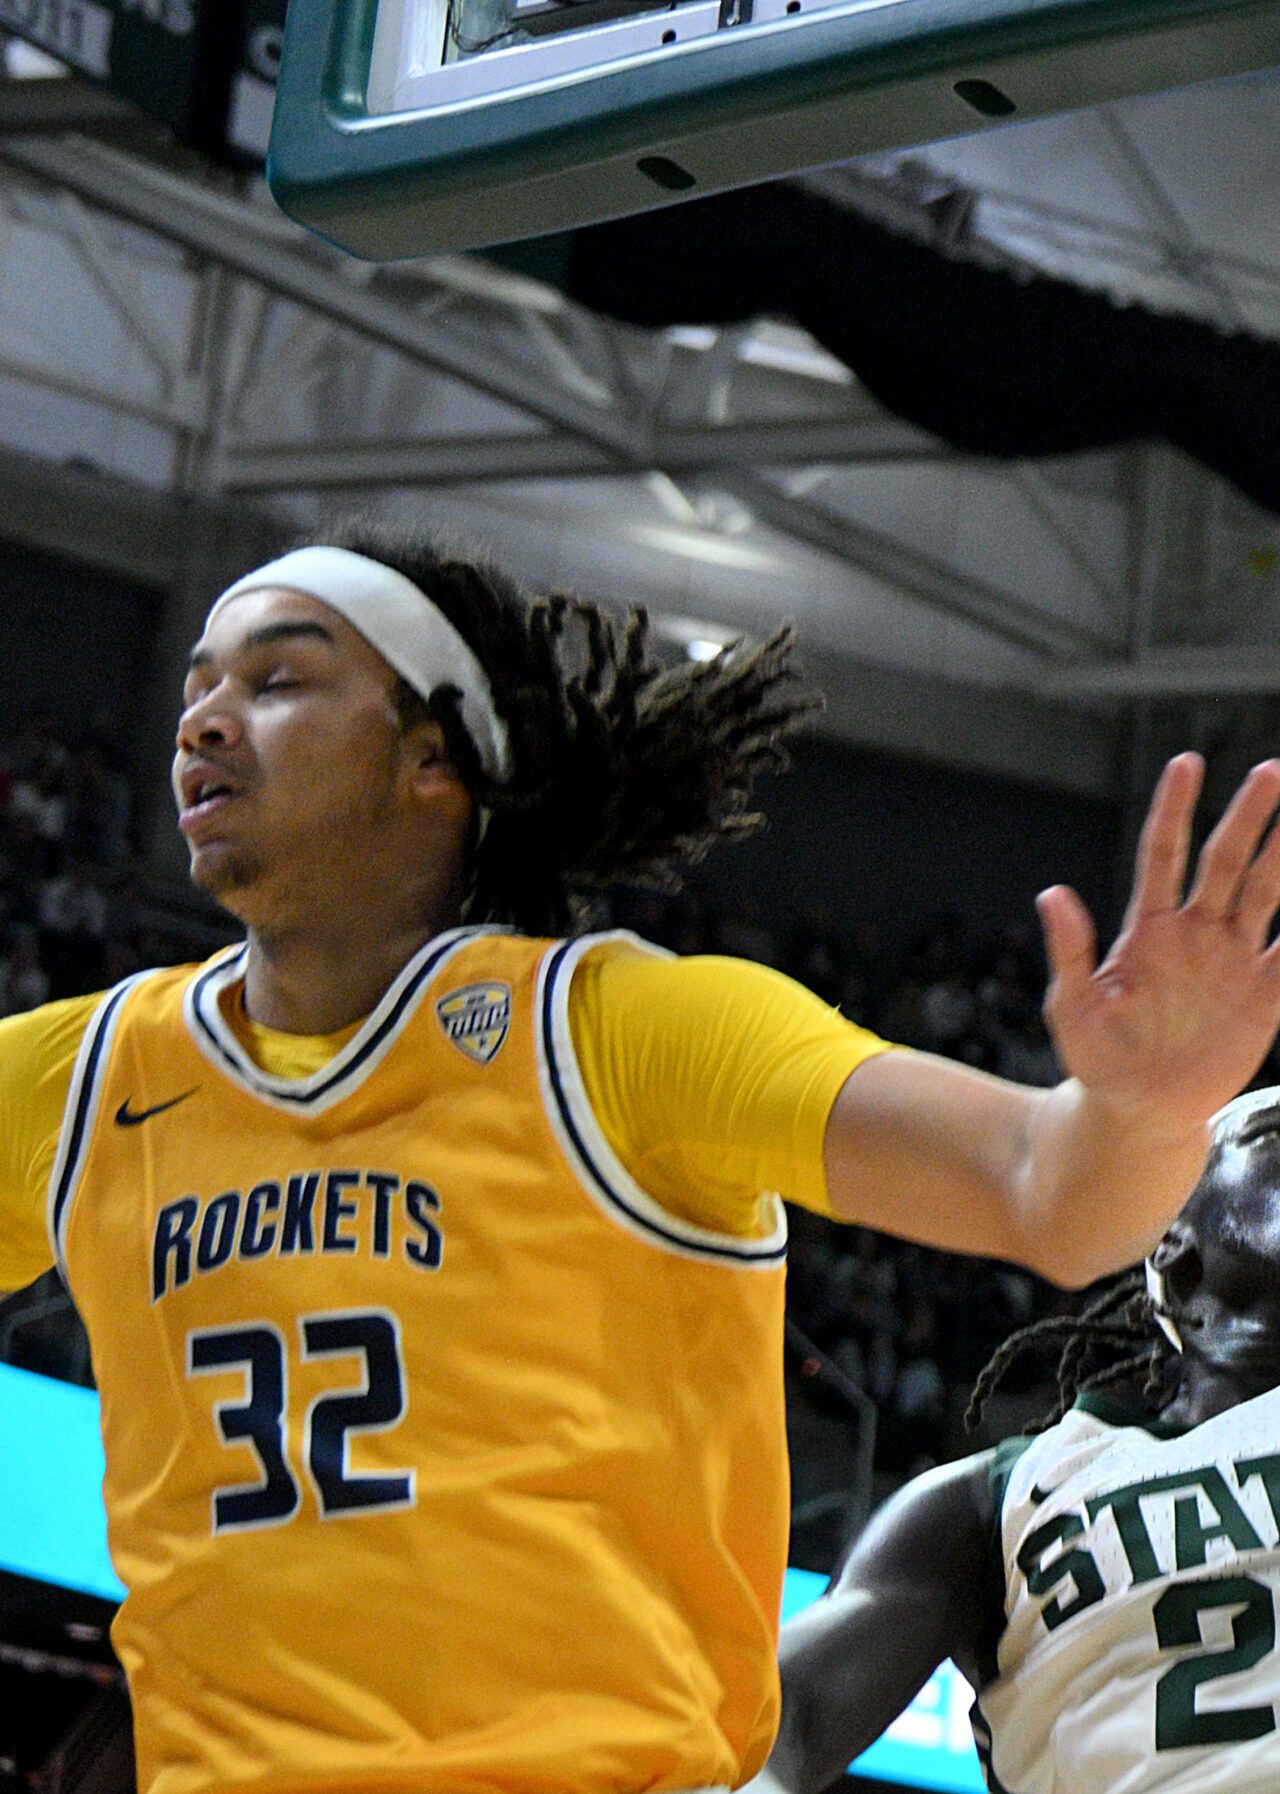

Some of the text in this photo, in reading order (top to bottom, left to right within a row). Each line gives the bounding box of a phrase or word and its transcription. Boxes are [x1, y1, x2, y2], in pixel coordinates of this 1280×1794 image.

[151, 1168, 443, 1307] ROCKETS
[186, 1305, 417, 1536] 32
[1152, 1574, 1277, 1754] 2
